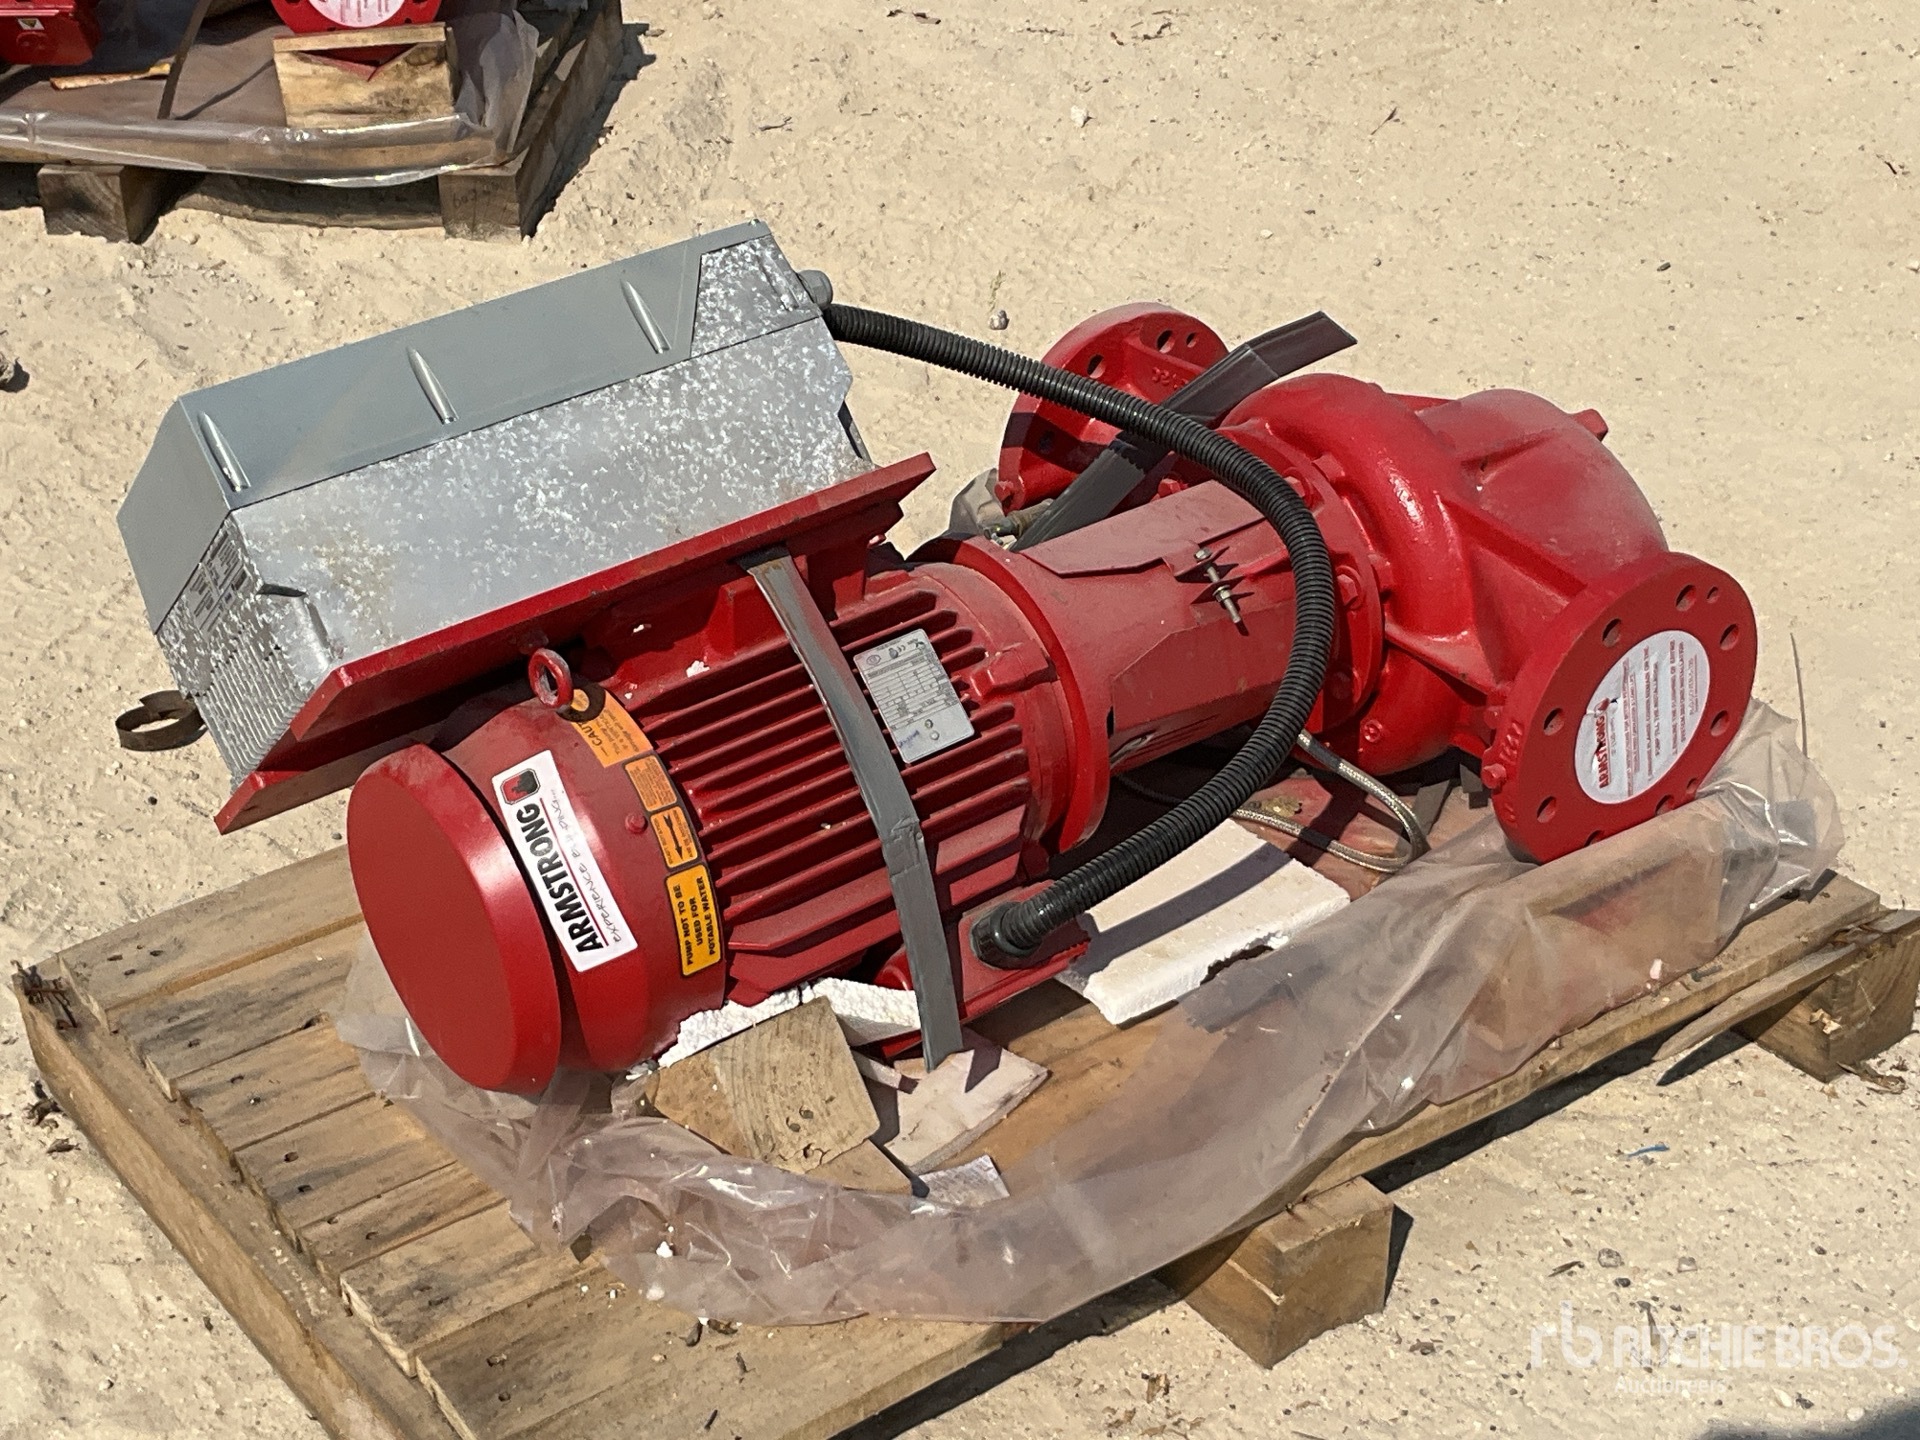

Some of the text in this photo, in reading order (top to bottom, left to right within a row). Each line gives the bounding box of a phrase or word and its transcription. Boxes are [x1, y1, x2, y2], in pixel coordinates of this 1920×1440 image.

[577, 721, 603, 747] CAUT
[516, 804, 604, 953] ARMSTRONG
[579, 863, 622, 942] EXPERIENCE
[696, 876, 716, 955] POTABLE WATER
[673, 884, 694, 966] PUMP NOT TO BE
[689, 897, 703, 946] USED FOR
